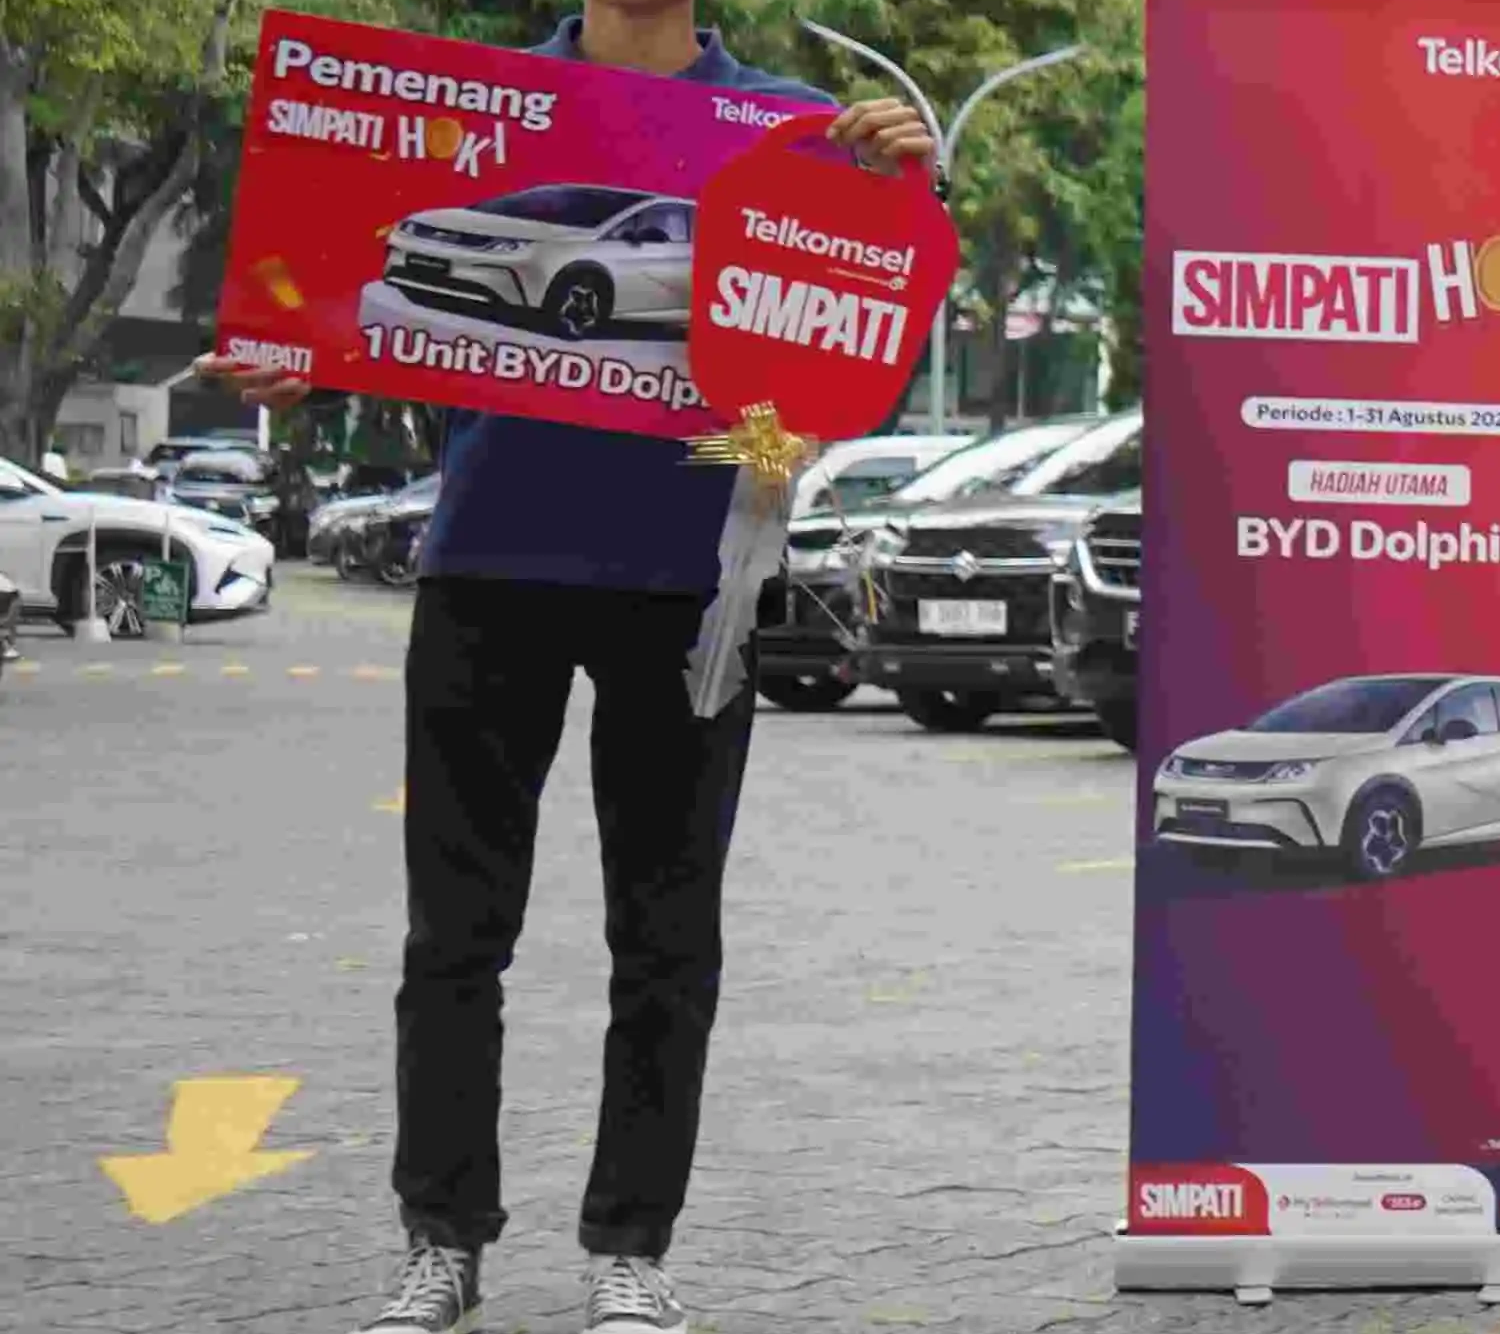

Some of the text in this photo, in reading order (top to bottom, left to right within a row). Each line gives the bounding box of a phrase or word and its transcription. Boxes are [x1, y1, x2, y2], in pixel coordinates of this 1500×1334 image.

[273, 38, 557, 132] Pemenang
[268, 99, 384, 149] SIMPATI
[711, 96, 794, 129] Telko
[741, 208, 915, 276] Telkomsel
[710, 265, 909, 366] SIMPATI
[1183, 259, 1409, 334] SIMPATI
[363, 326, 709, 411] 1 Unit BYD Dolp
[1389, 407, 1466, 428] Agustus
[1310, 470, 1449, 497] HADIAH UTAMA
[1236, 517, 1341, 559] BYD
[1140, 1182, 1243, 1218] SIMPATI
